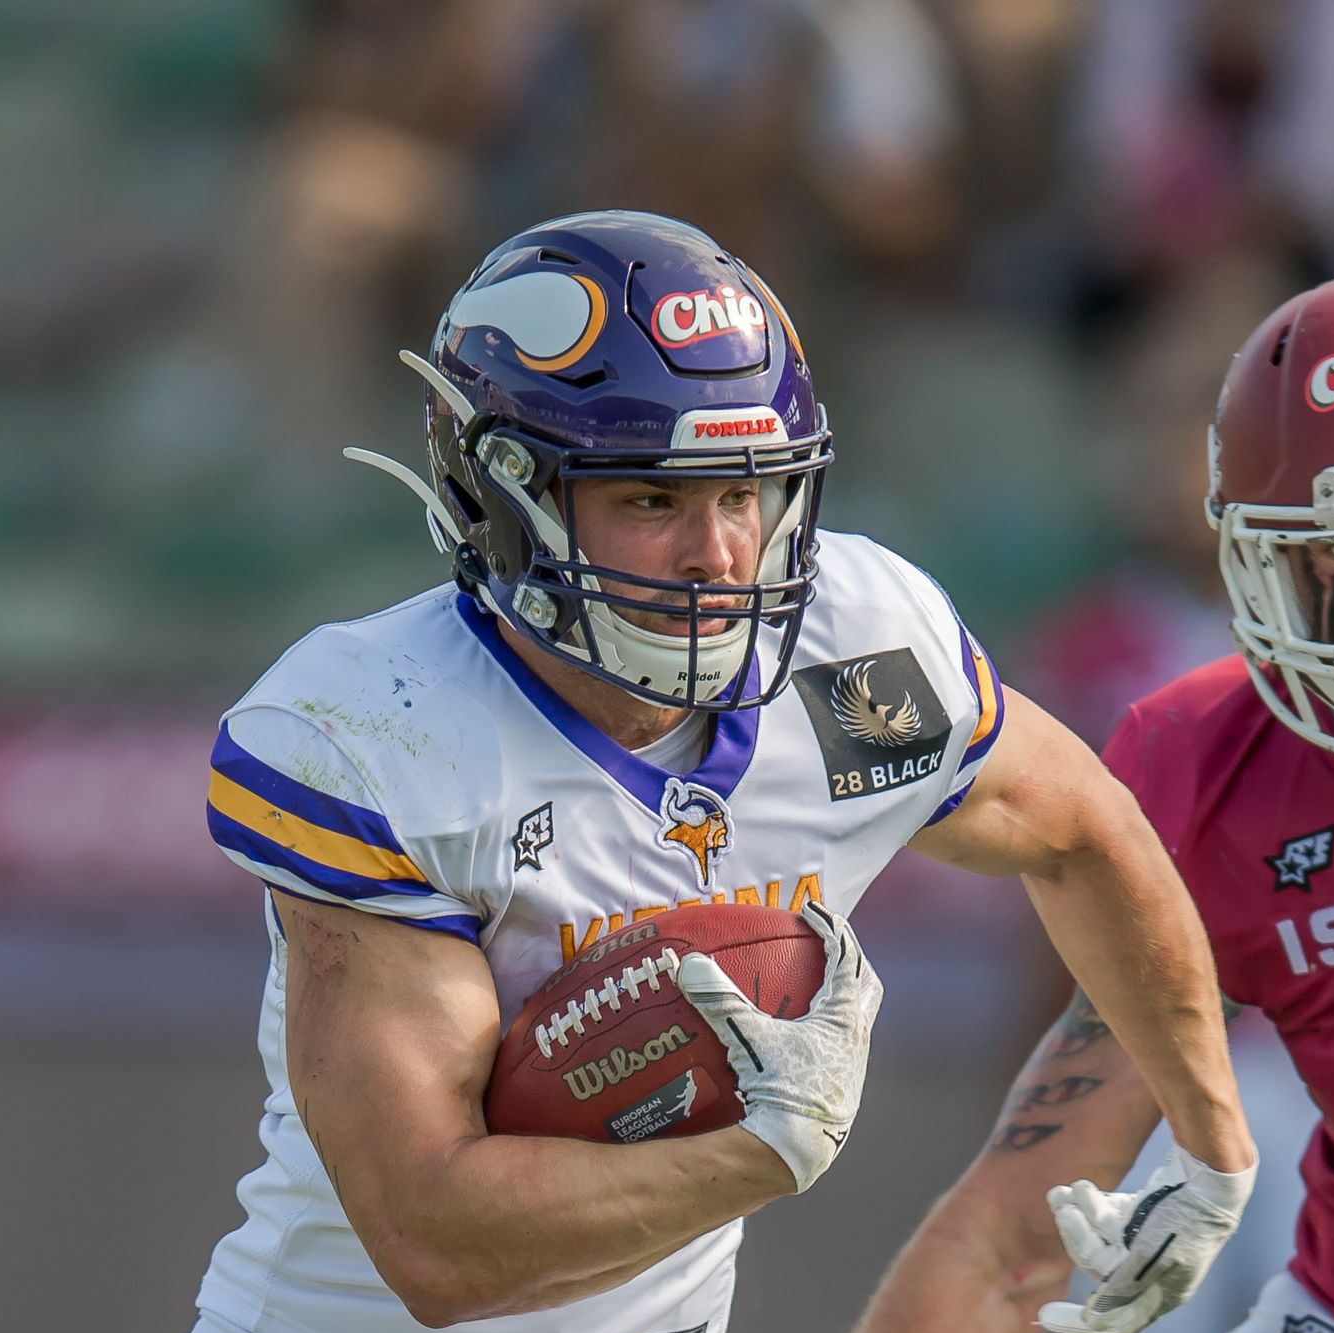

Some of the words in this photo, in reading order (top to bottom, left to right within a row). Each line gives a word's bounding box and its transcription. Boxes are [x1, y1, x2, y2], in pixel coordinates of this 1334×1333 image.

[657, 286, 765, 342] Chio
[694, 417, 777, 439] FORELLE
[832, 770, 864, 796] 28
[870, 750, 942, 789] BLACK
[563, 1024, 698, 1101] Wilson
[611, 1097, 662, 1130] EUROPEAN
[617, 1113, 654, 1138] LEAGUE
[623, 1115, 672, 1143] FOOTBALL
